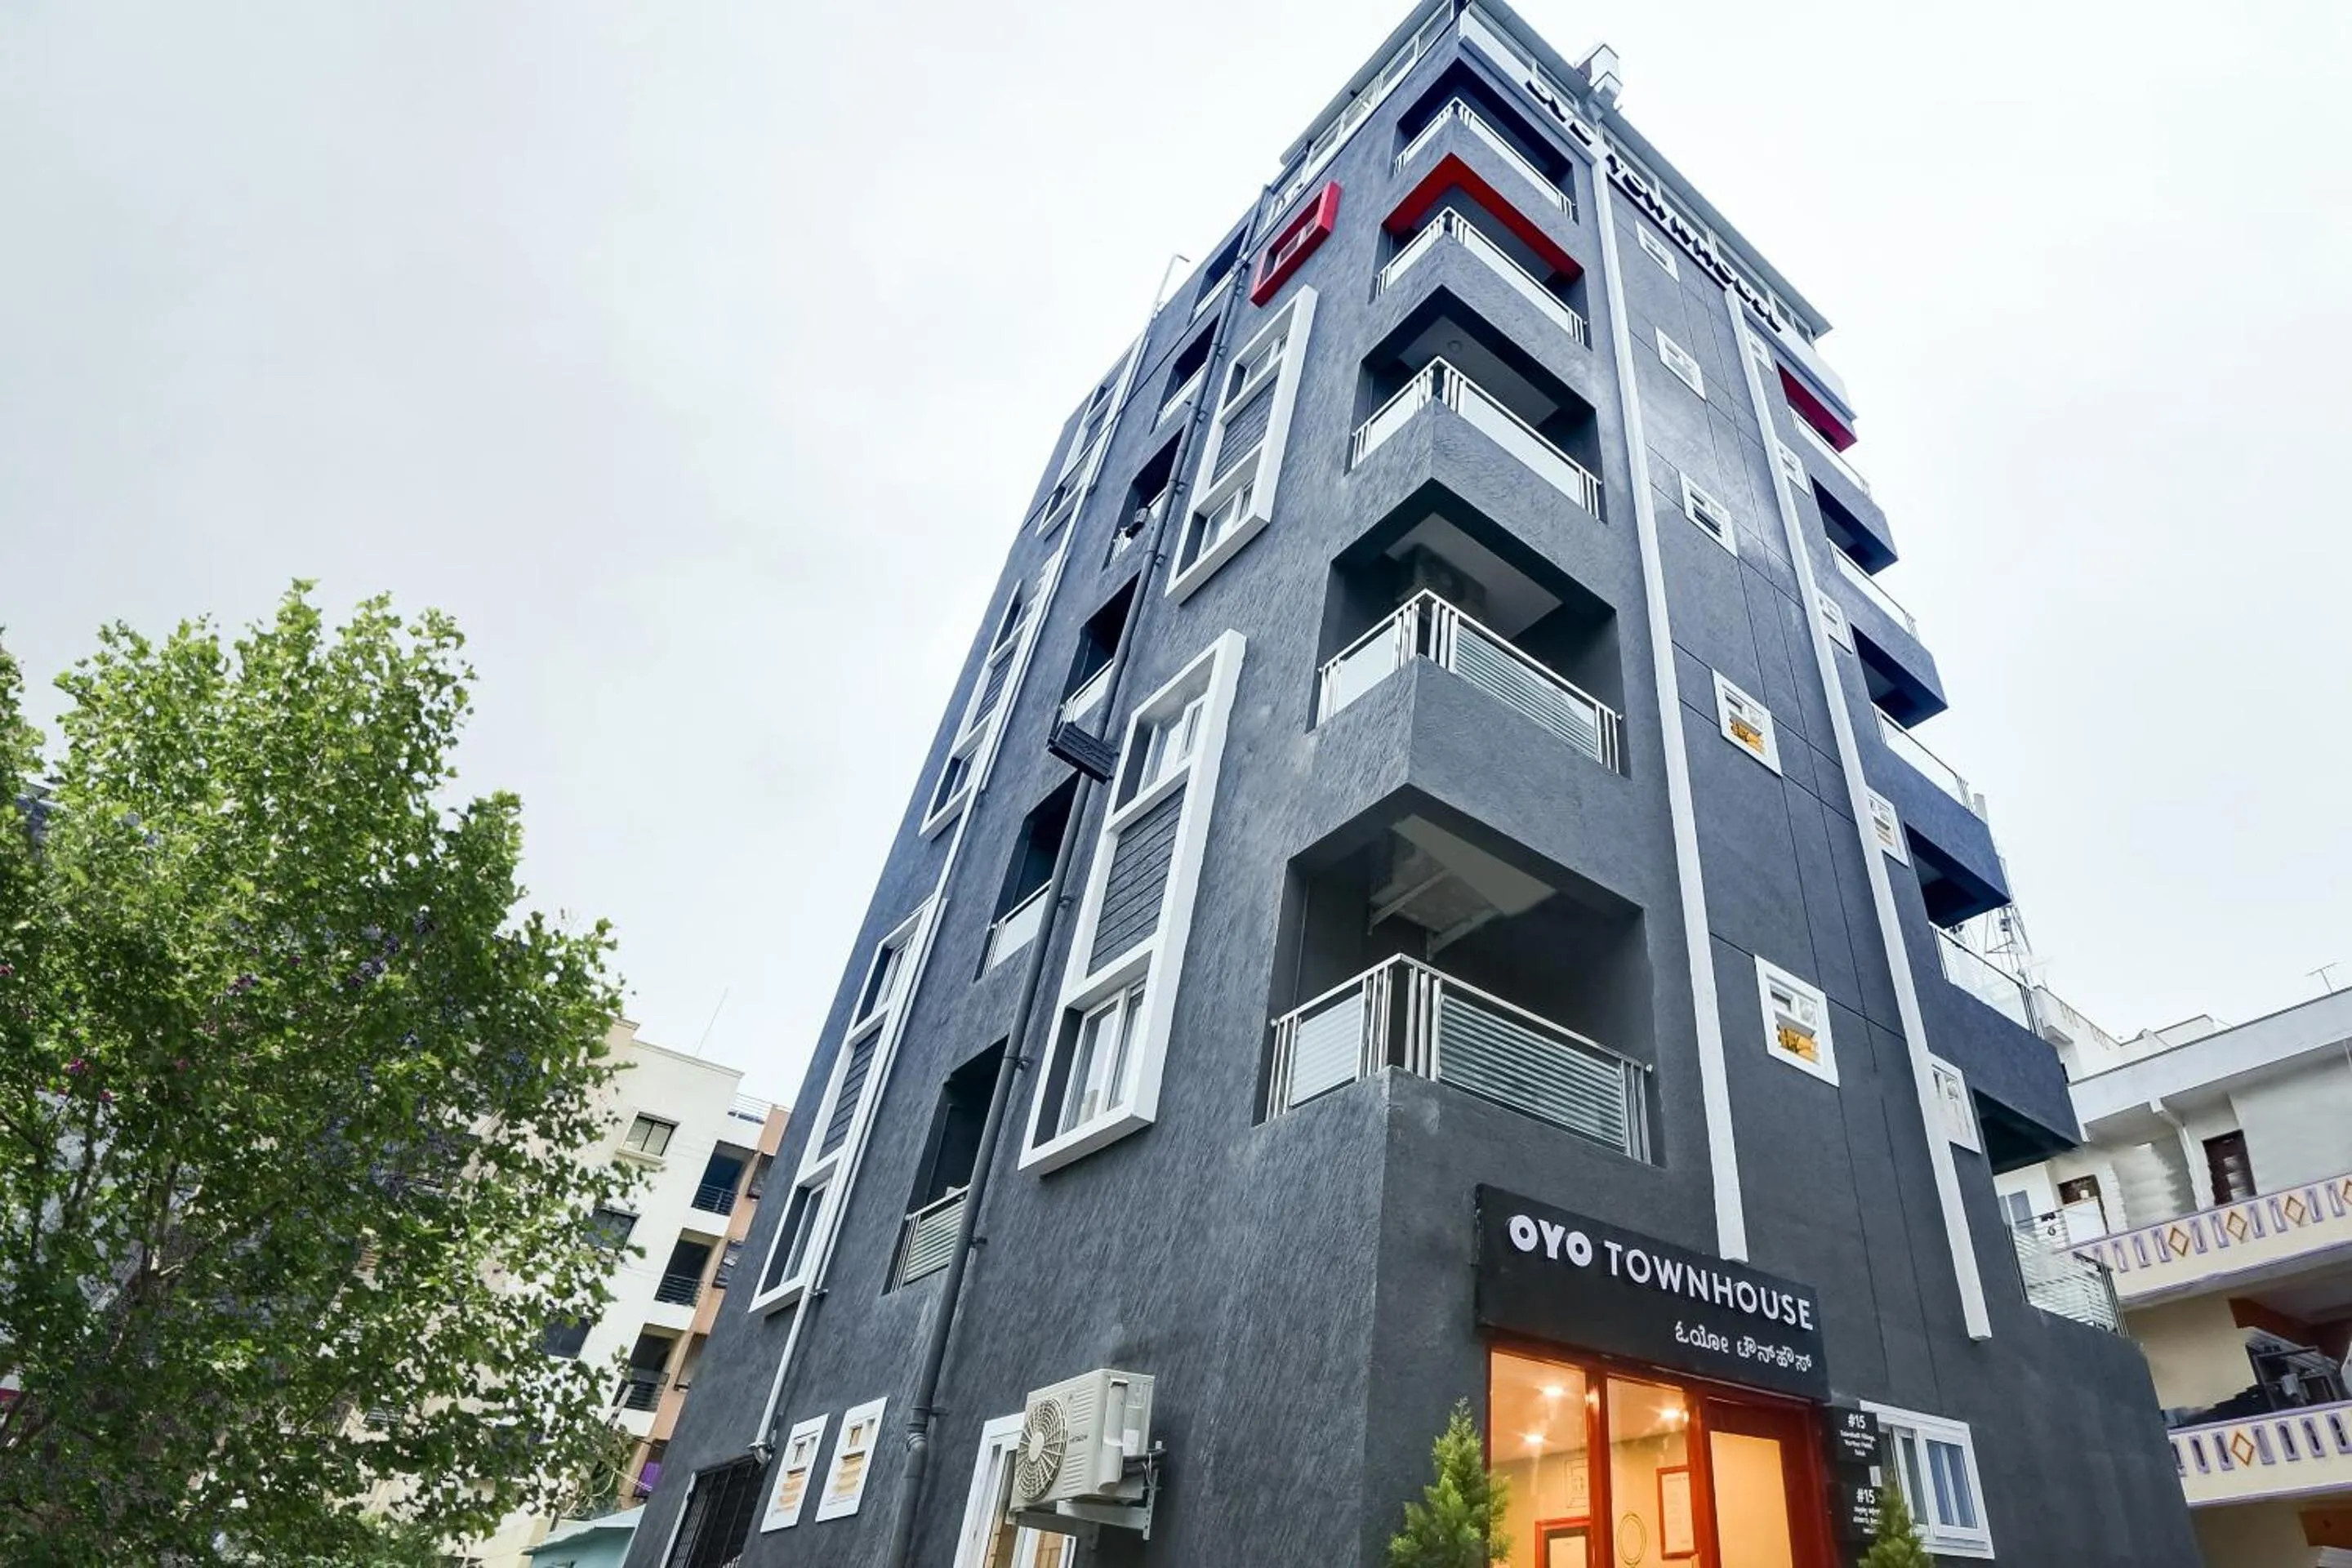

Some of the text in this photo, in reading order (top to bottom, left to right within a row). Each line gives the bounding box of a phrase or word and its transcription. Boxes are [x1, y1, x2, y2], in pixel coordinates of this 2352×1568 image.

[1509, 1214, 1814, 1330] OYO TOWNHOUSE
[1855, 1487, 1876, 1504] #15
